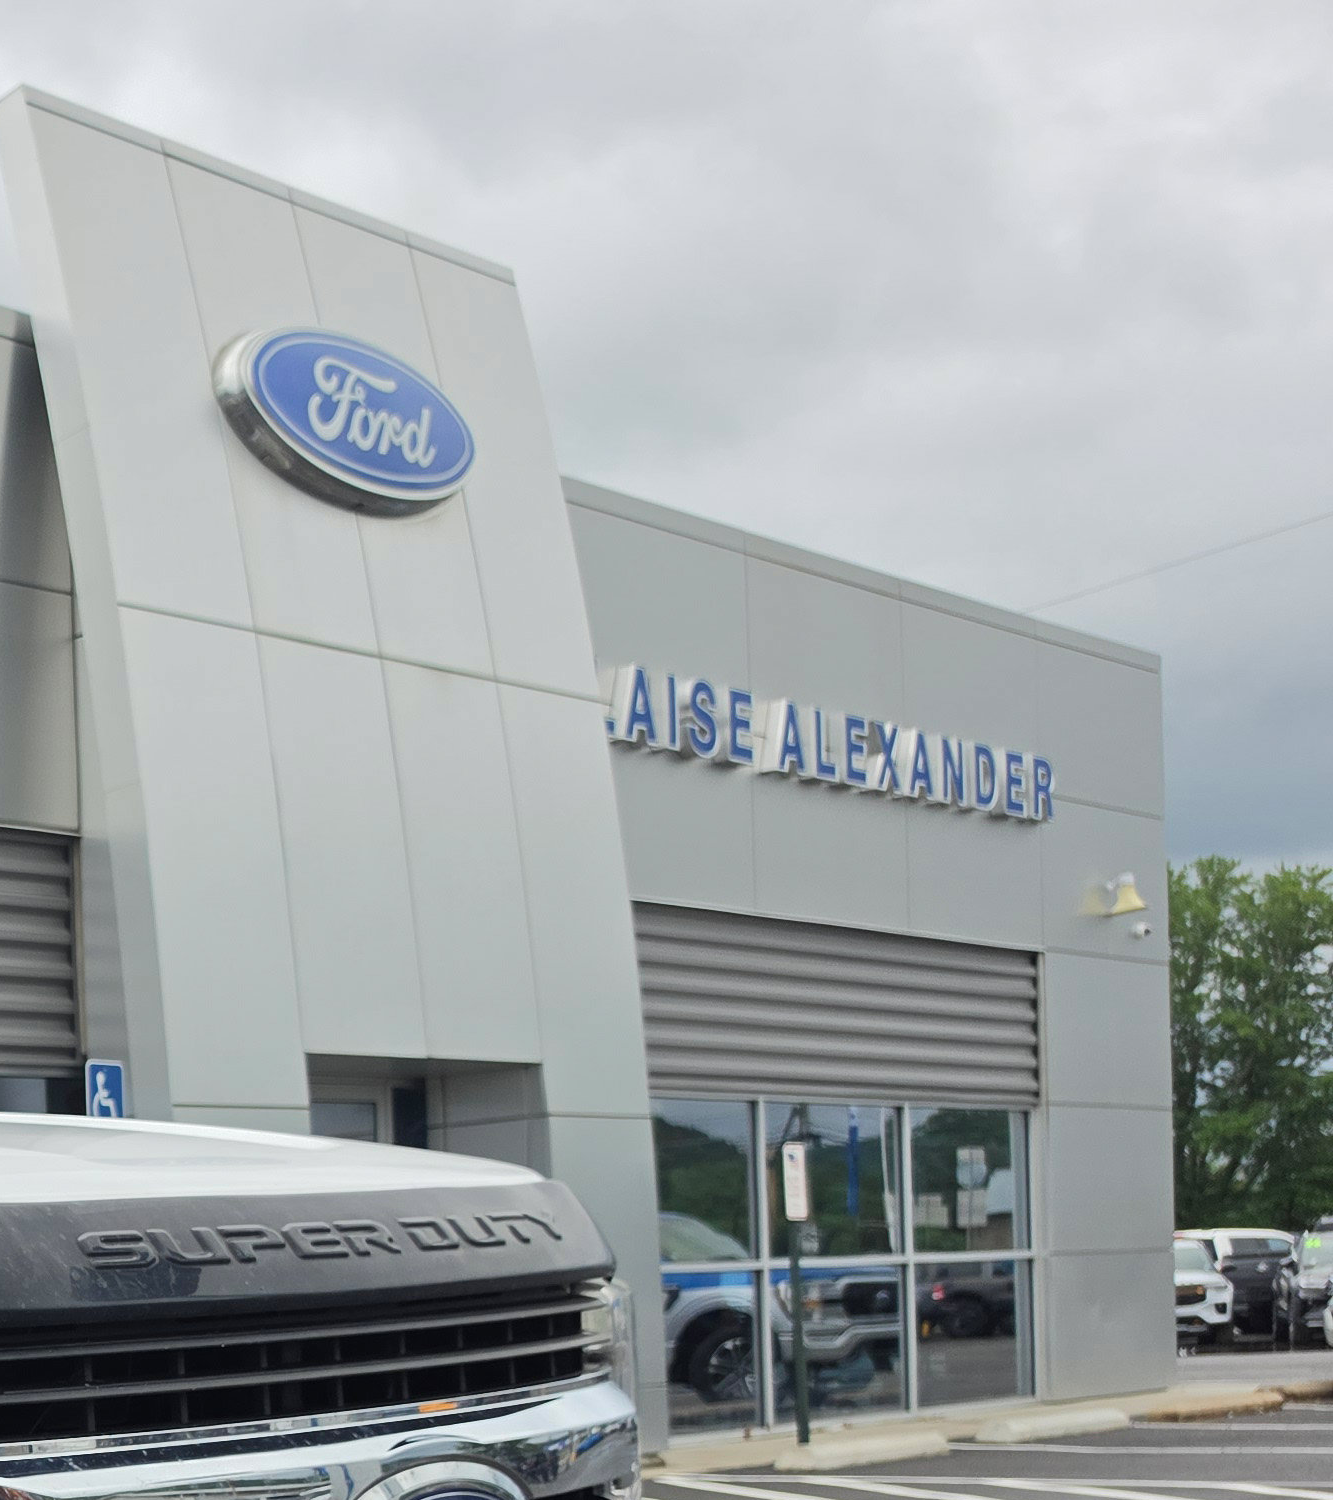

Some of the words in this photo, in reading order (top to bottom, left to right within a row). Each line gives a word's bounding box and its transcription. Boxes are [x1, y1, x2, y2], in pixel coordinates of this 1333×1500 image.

[307, 355, 436, 468] Ford
[605, 668, 755, 765] AISE
[777, 698, 1055, 821] ALEXANDER
[76, 1217, 401, 1271] SUPER
[397, 1209, 563, 1252] DUTY
